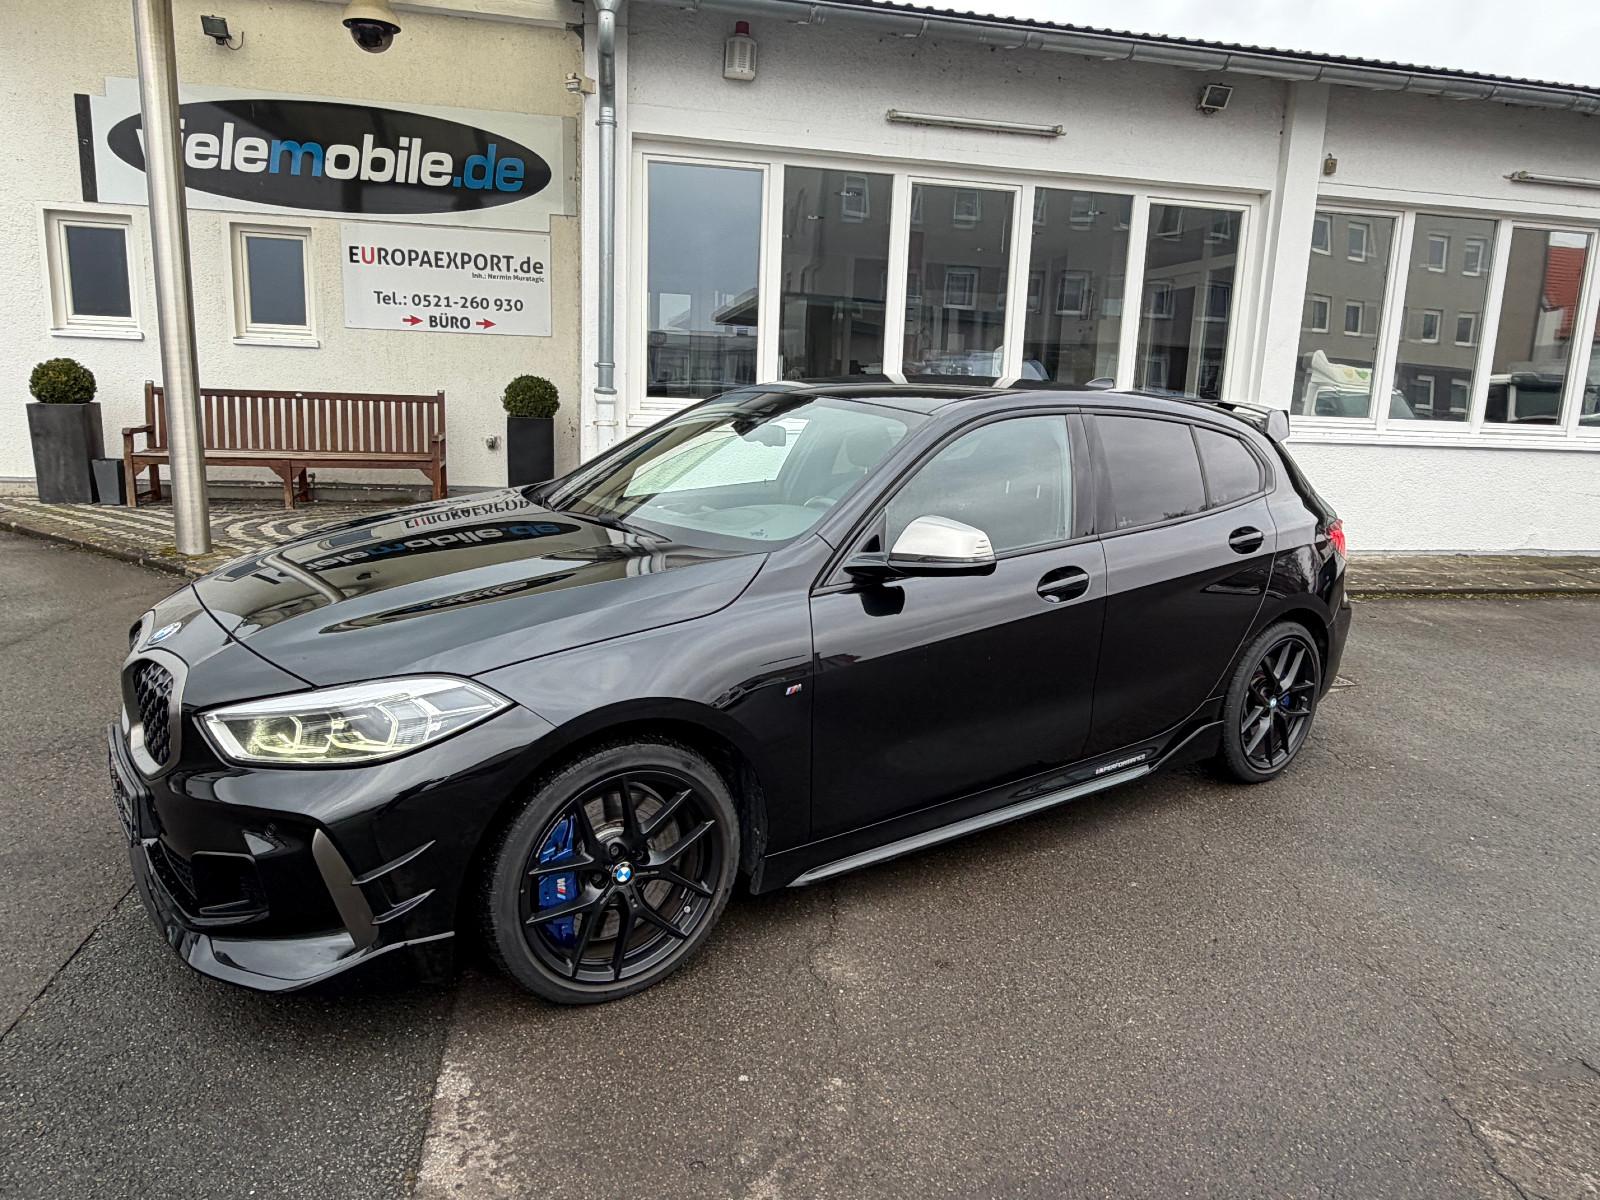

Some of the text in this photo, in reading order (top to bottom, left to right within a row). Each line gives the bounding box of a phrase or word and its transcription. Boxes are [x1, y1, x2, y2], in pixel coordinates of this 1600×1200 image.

[348, 245, 544, 275] EUROPAEXPORT.de
[373, 290, 524, 312] Tel.: 0521-260 930
[428, 313, 471, 330] BÜRO
